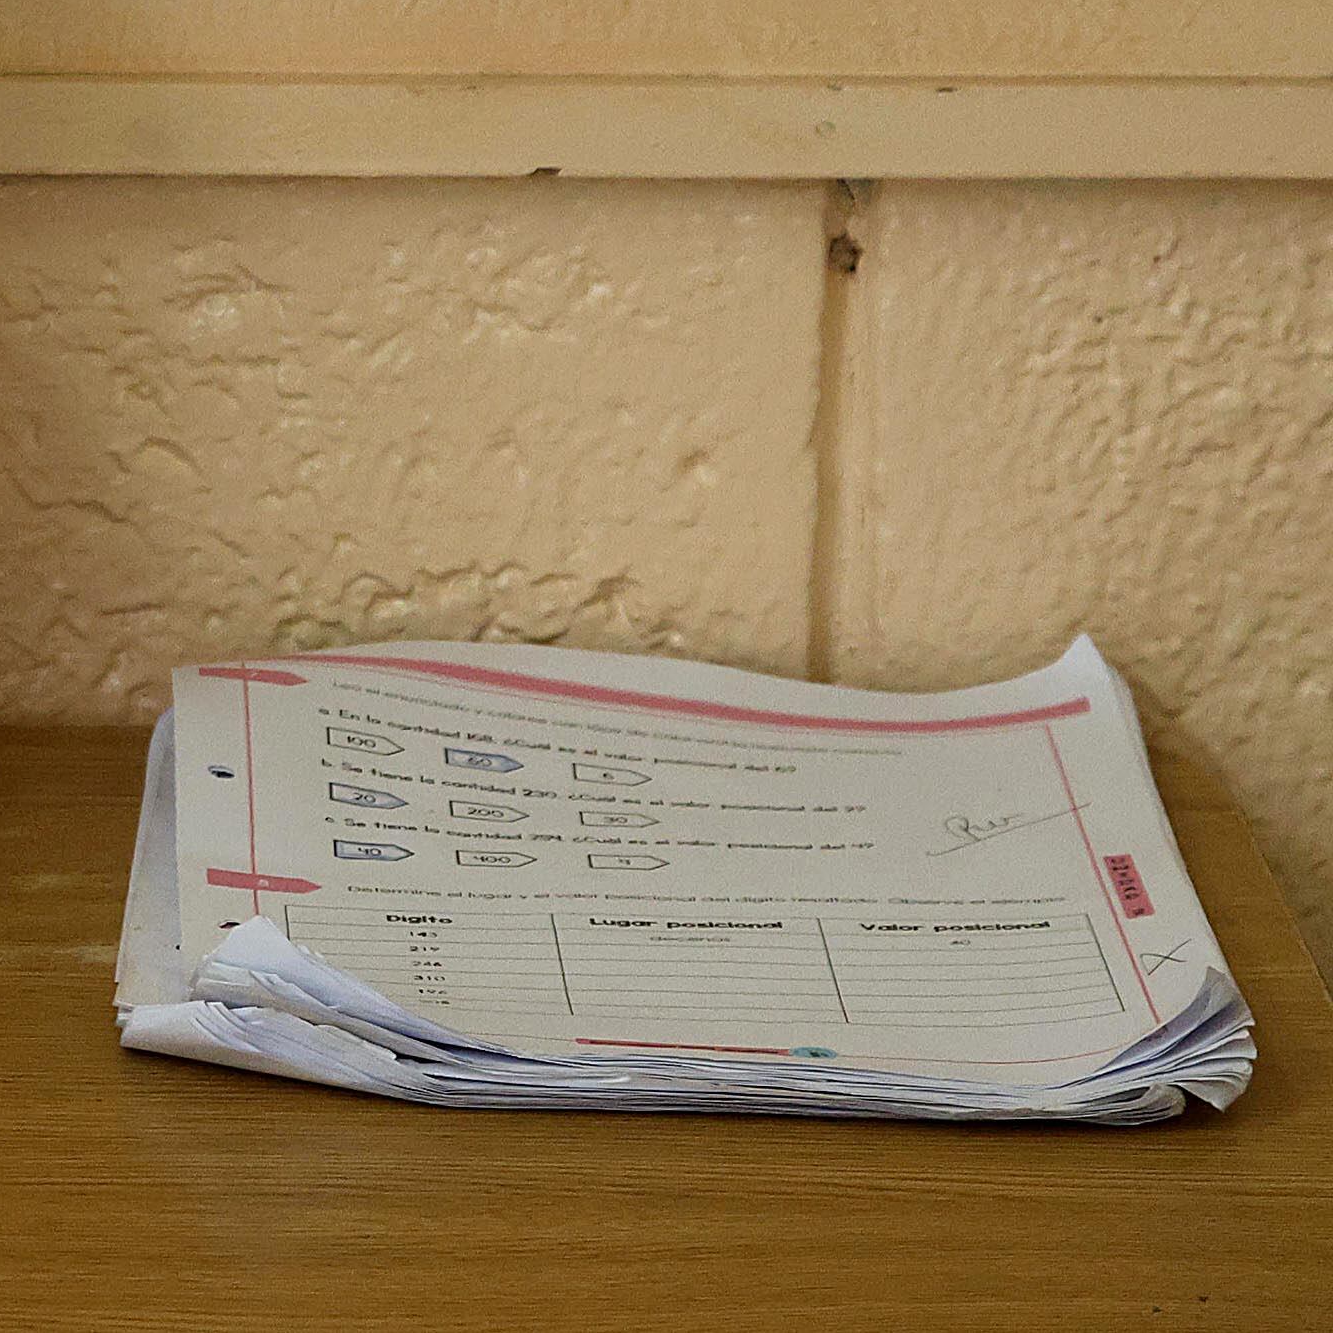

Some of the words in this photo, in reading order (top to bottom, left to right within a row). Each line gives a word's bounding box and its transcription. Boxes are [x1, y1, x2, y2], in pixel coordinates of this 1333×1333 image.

[588, 917, 658, 928] Lugar
[666, 920, 784, 931] posicional
[859, 922, 924, 932] Valor
[933, 920, 1052, 933] posicional
